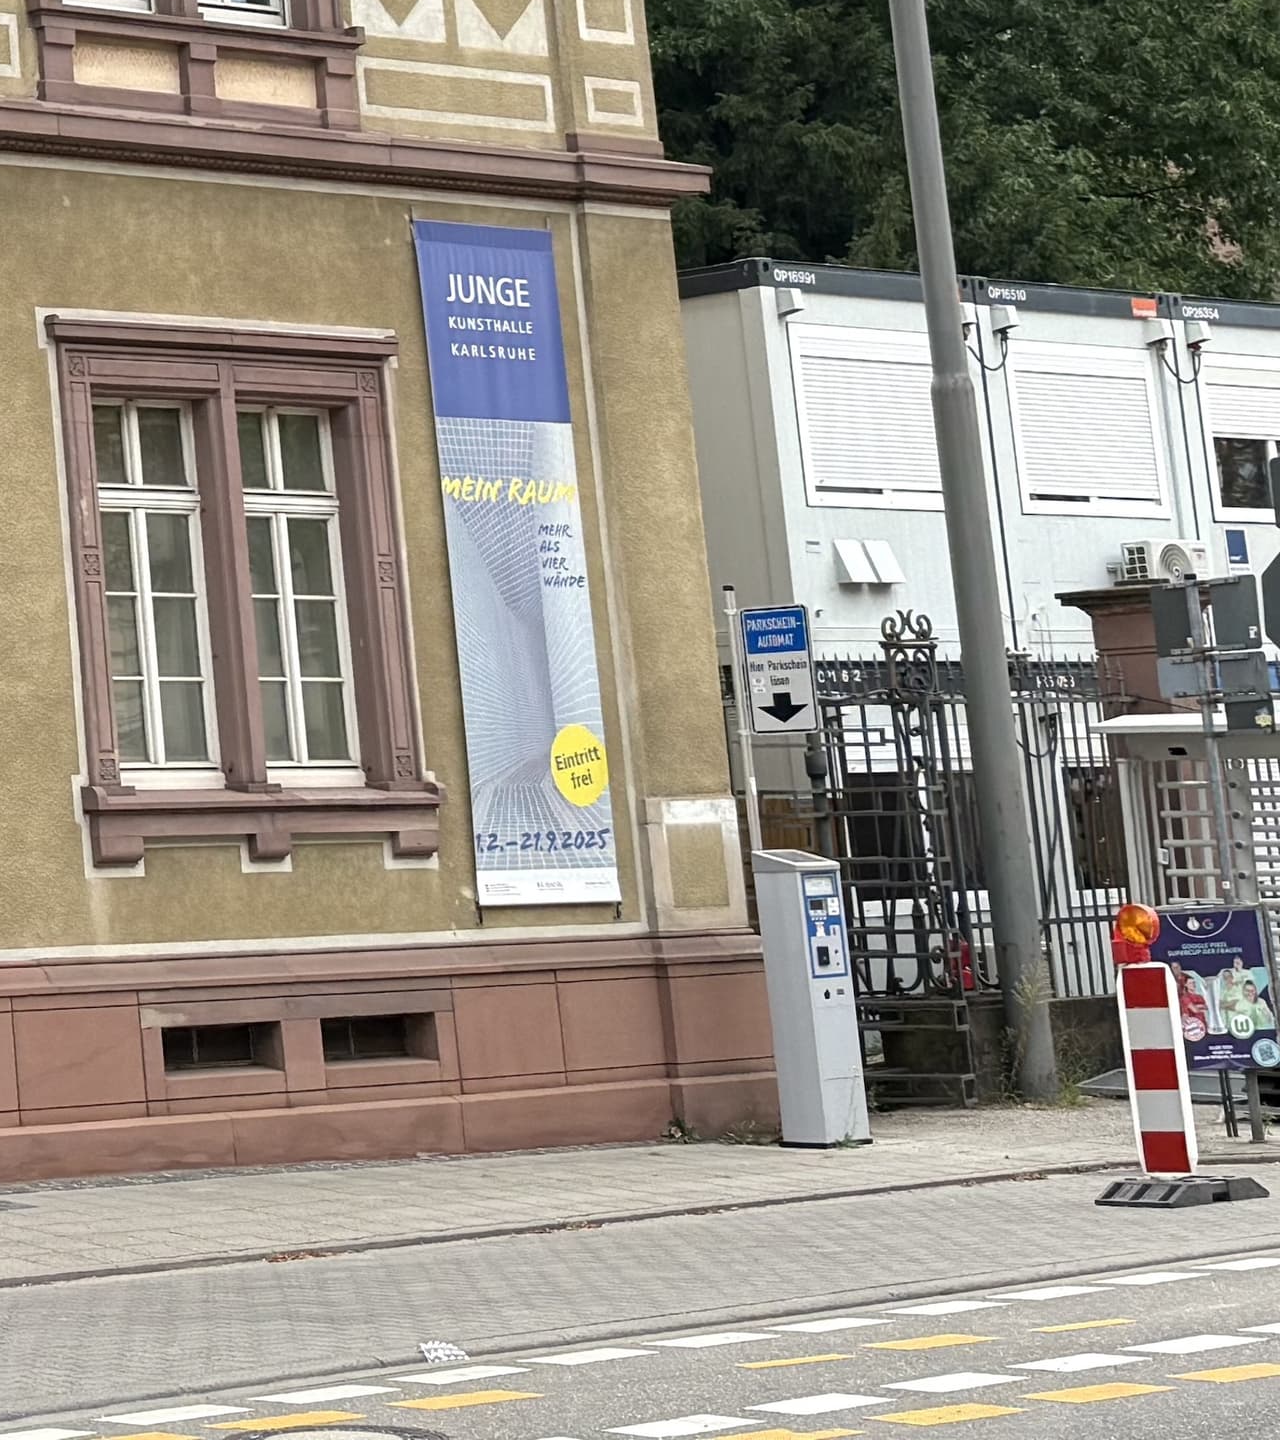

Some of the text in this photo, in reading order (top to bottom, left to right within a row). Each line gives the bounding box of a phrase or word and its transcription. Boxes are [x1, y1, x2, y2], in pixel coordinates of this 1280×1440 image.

[774, 269, 816, 284] OP16991
[447, 274, 530, 307] JUNGE
[448, 316, 533, 334] KUNSTHALLE
[451, 343, 536, 361] KARLSRUHE
[441, 475, 578, 505] MEIN RAUM
[538, 523, 573, 538] MEHR
[540, 540, 561, 553] ALS
[542, 557, 570, 571] VIER
[543, 572, 587, 588] WÄNDE
[746, 617, 801, 632] PARKSCHEIN-
[757, 633, 794, 648] AUTOMAT
[767, 659, 807, 672] Parkschein
[554, 746, 601, 772] Eintritt
[571, 768, 593, 790] frei
